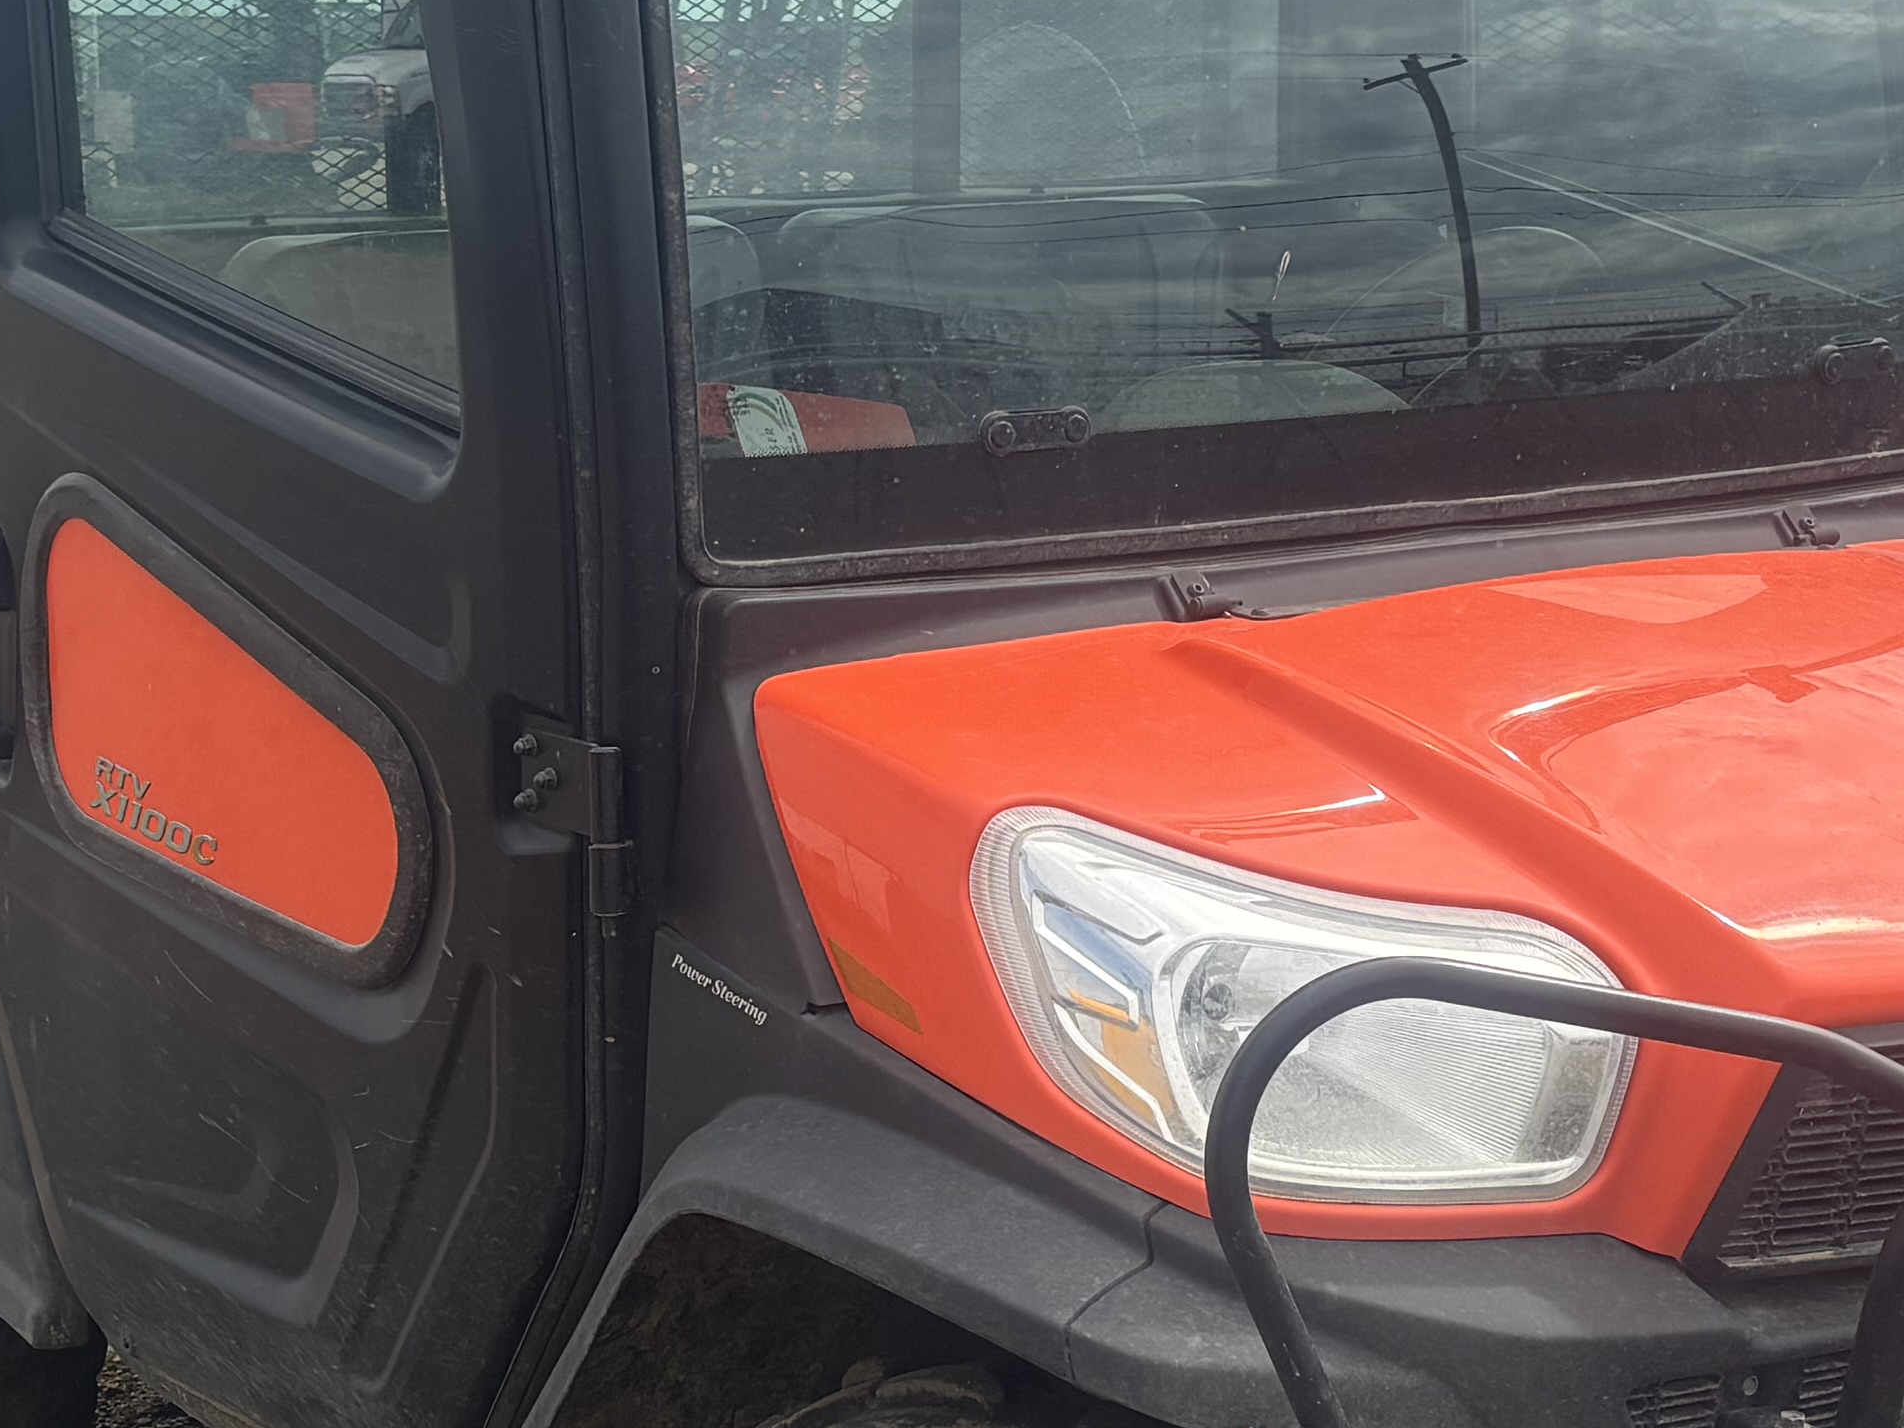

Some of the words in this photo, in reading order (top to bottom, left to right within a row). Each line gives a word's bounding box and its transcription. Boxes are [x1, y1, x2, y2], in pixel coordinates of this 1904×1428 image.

[96, 756, 151, 800] RTV
[90, 780, 218, 866] X1100C
[671, 953, 712, 988] Power
[711, 979, 768, 1026] Steering
